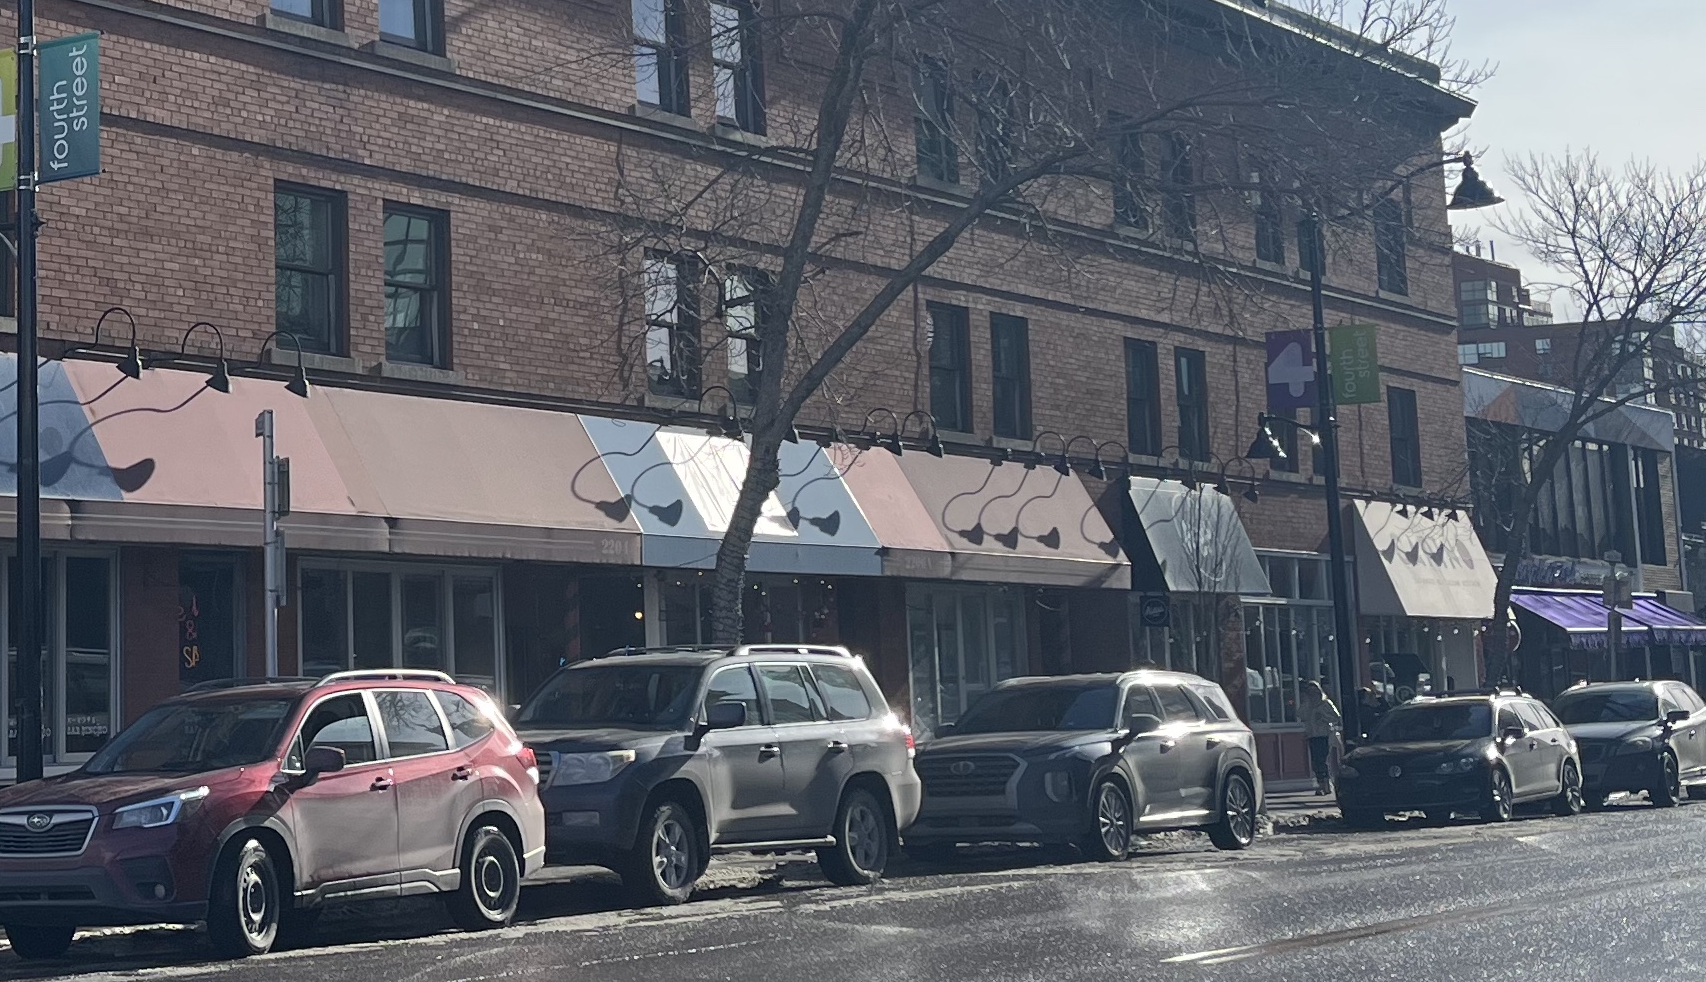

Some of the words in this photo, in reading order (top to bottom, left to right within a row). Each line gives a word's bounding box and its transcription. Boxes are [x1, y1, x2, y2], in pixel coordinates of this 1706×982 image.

[69, 43, 87, 131] street
[50, 80, 68, 170] fourth
[1268, 342, 1315, 397] 4
[1340, 348, 1357, 399] fourth
[1353, 330, 1370, 378] street
